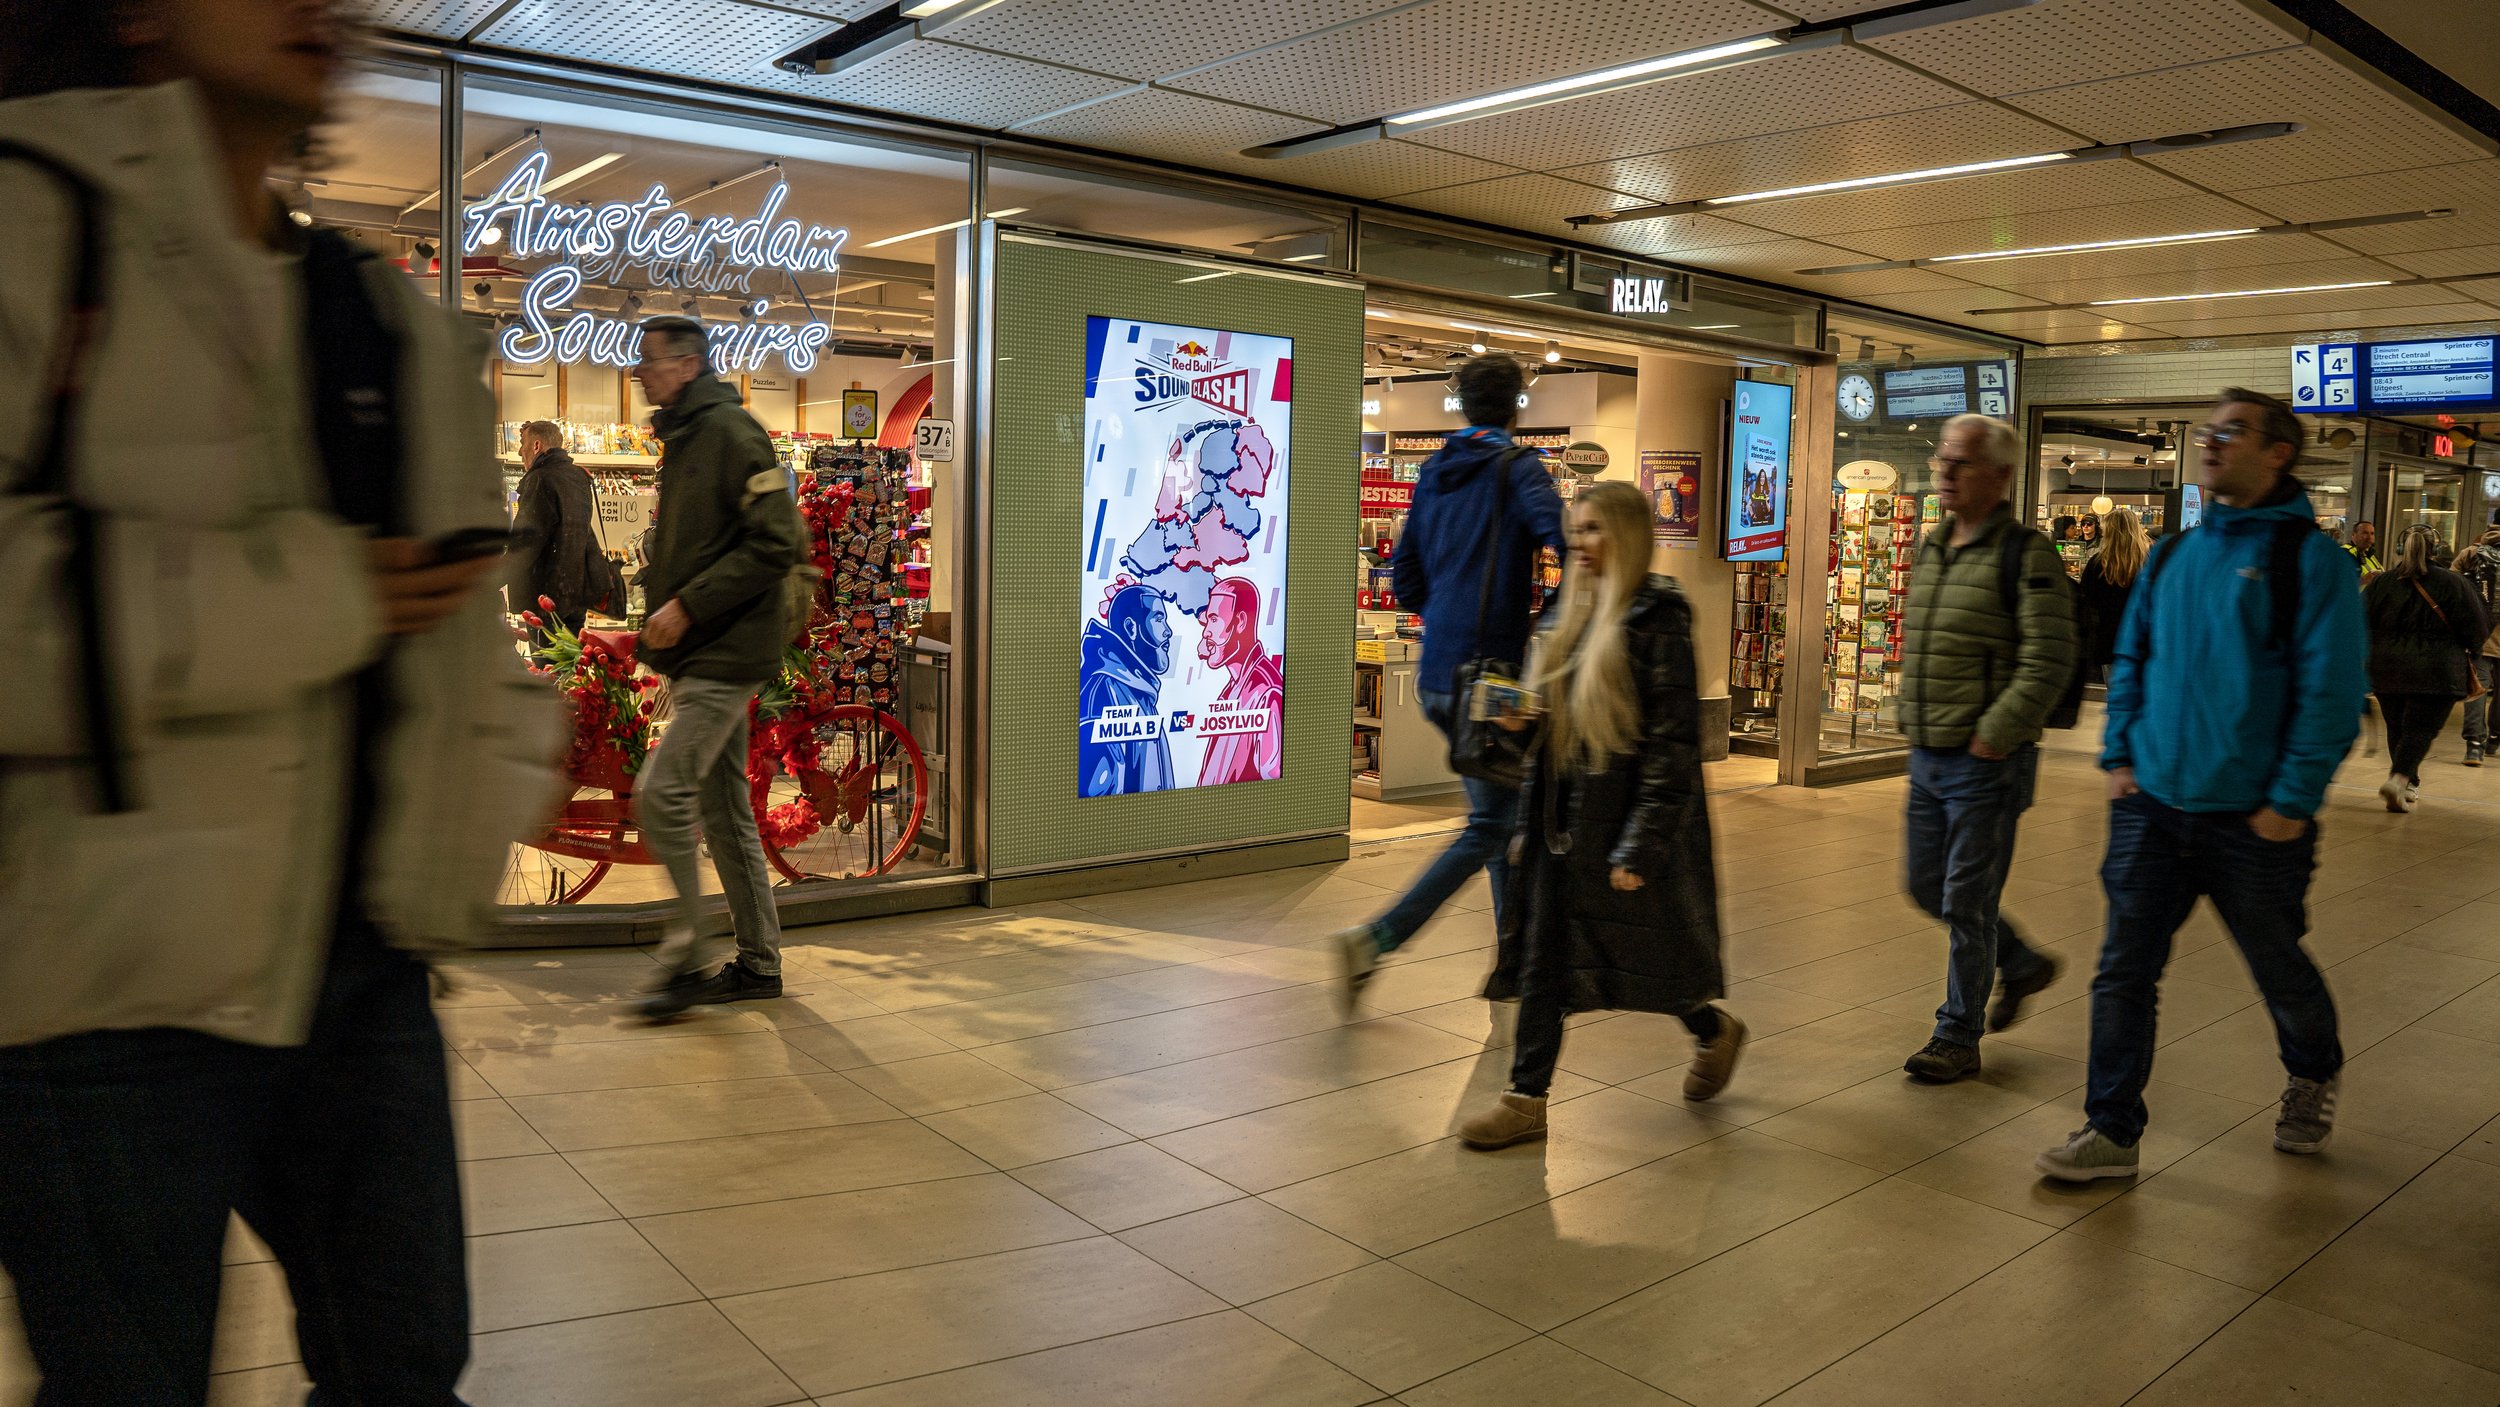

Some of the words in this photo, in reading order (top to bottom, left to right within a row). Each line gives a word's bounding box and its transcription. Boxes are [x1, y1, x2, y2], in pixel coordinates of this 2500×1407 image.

[465, 151, 849, 272] Amsterdam
[1613, 279, 1664, 312] RELAY
[501, 265, 830, 375] Sounirs
[506, 364, 533, 372] Women
[1172, 358, 1192, 372] Red
[1193, 359, 1212, 373] Bull
[1135, 367, 1190, 402] SOUND
[1192, 371, 1246, 413] CLASH
[1739, 415, 1760, 424] NIEUW
[920, 427, 943, 446] 37
[1383, 543, 1390, 553] 2
[1362, 595, 1369, 605] 6
[1386, 595, 1392, 605] 7
[1106, 709, 1132, 719] TEAM
[1208, 703, 1233, 713] TEAM
[1200, 714, 1264, 731] JOSYLVIO
[1099, 722, 1141, 738] MULA
[1146, 721, 1156, 735] B
[558, 838, 611, 850] FLOWERBIKEMAN
